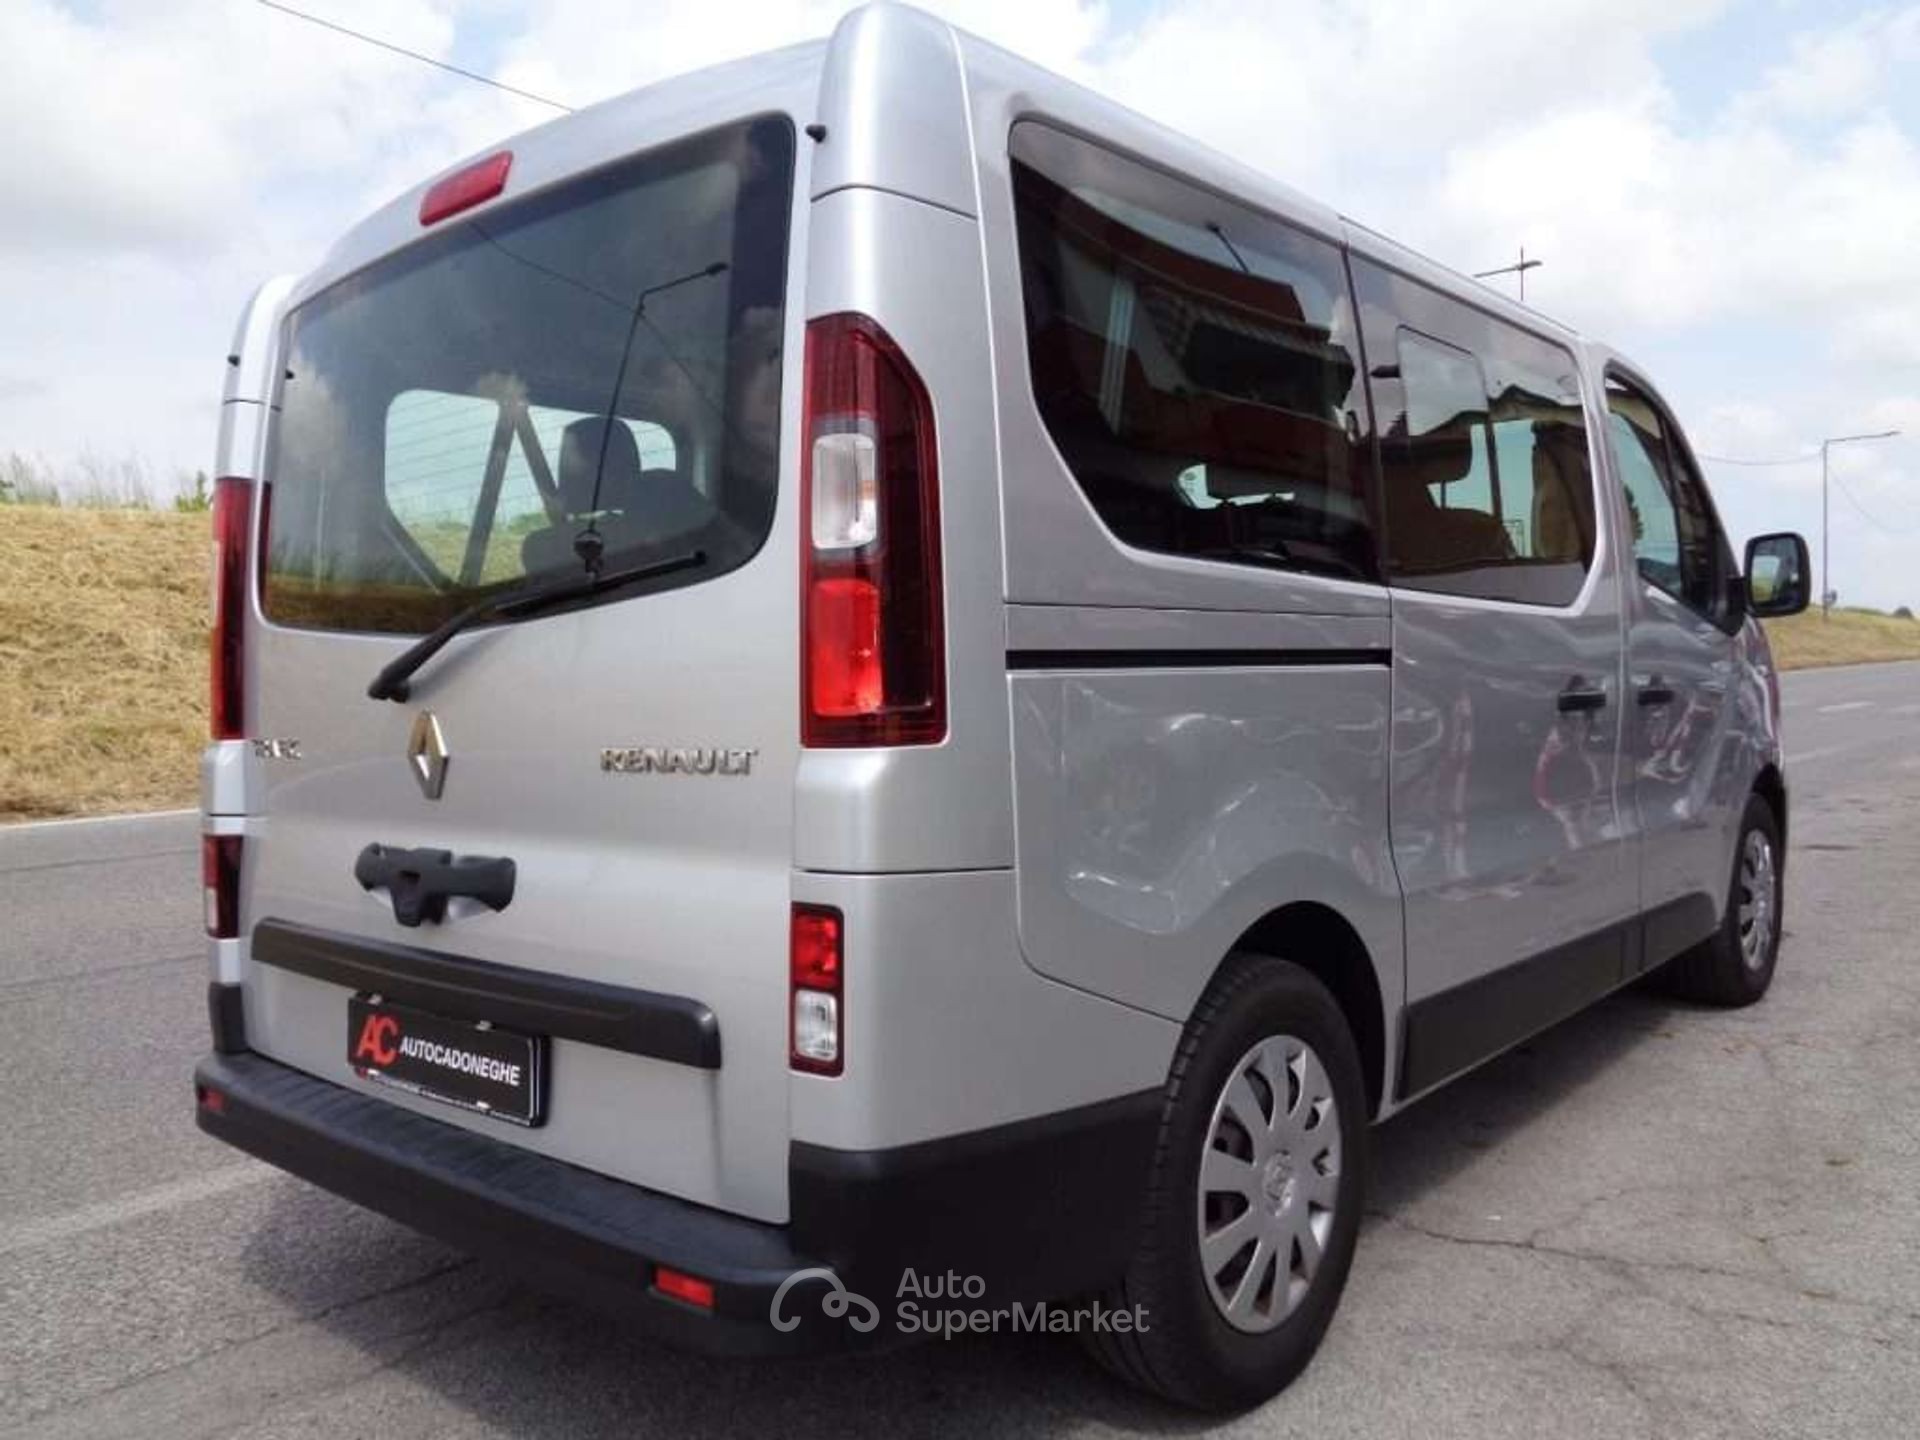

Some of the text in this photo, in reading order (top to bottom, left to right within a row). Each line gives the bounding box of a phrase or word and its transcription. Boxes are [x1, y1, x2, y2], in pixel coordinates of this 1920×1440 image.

[600, 748, 759, 776] RENAULT
[356, 1015, 521, 1086] AC AUTOCADONEGHE
